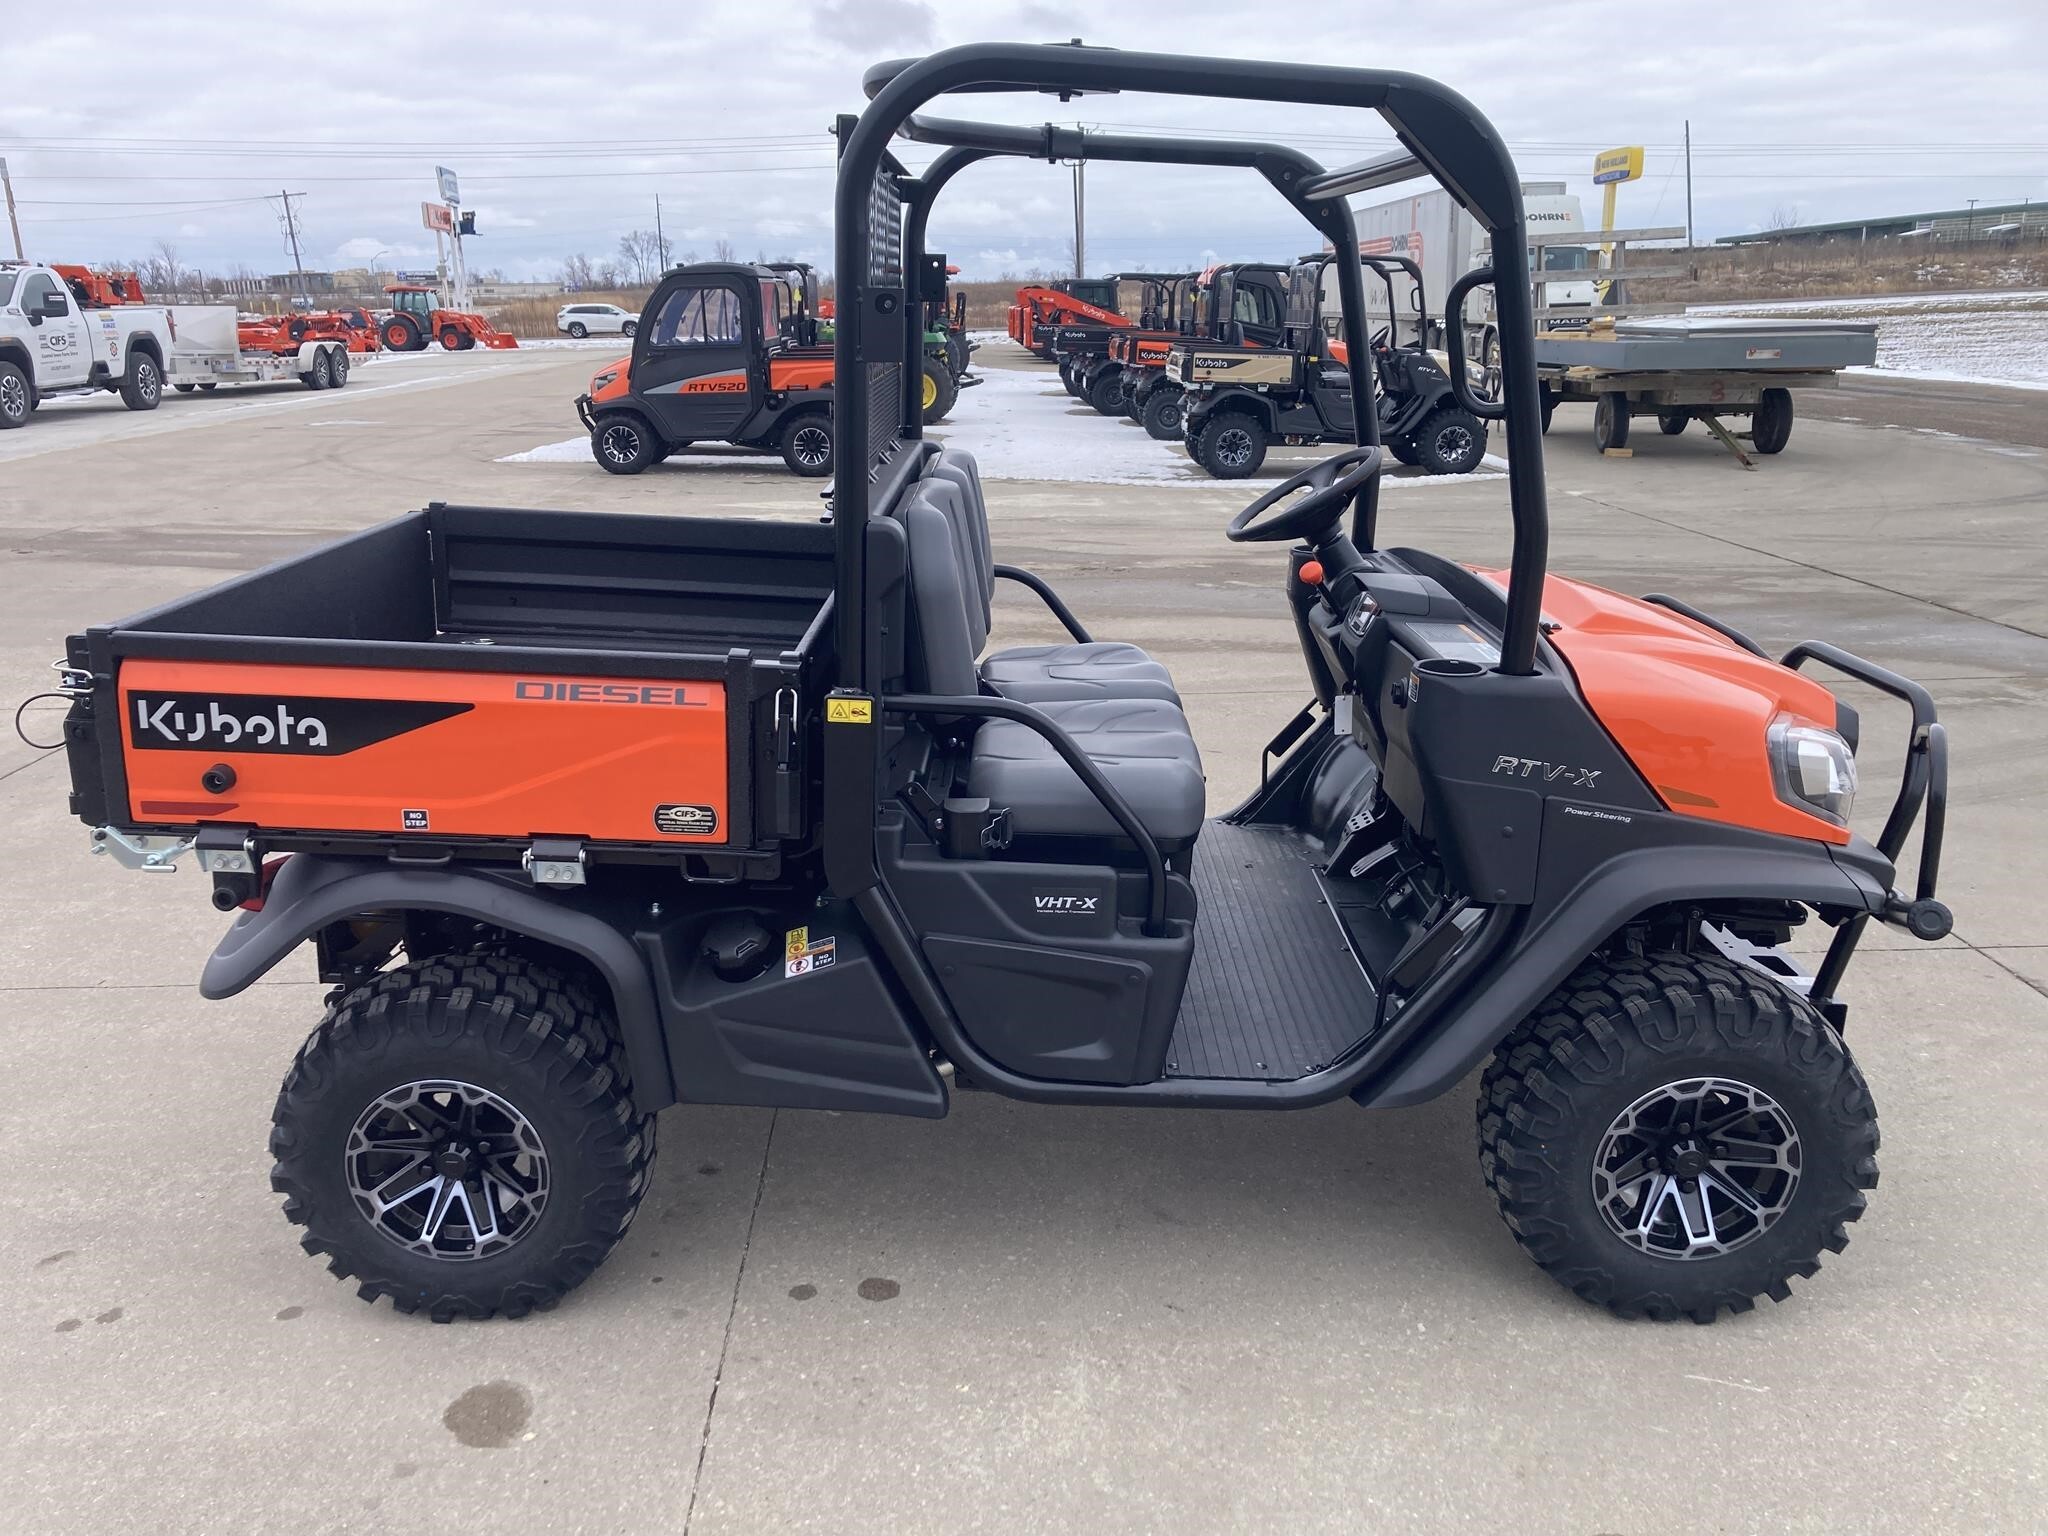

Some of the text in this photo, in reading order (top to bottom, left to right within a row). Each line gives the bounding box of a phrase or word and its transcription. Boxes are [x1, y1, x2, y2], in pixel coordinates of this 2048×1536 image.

[1525, 212, 1564, 222] OHRN
[1082, 304, 1105, 320] Kubota
[49, 335, 67, 346] CIFS
[1141, 350, 1169, 360] Kubota
[1195, 357, 1228, 368] Kubota
[688, 382, 746, 392] RTV520
[516, 682, 708, 706] DIESEL
[137, 699, 328, 747] Kubota
[1491, 755, 1602, 788] RTV-X
[674, 810, 697, 818] CIFS
[1564, 806, 1632, 823] Power Steering
[1034, 896, 1098, 909] VHT-X
[815, 957, 832, 966] STEP
